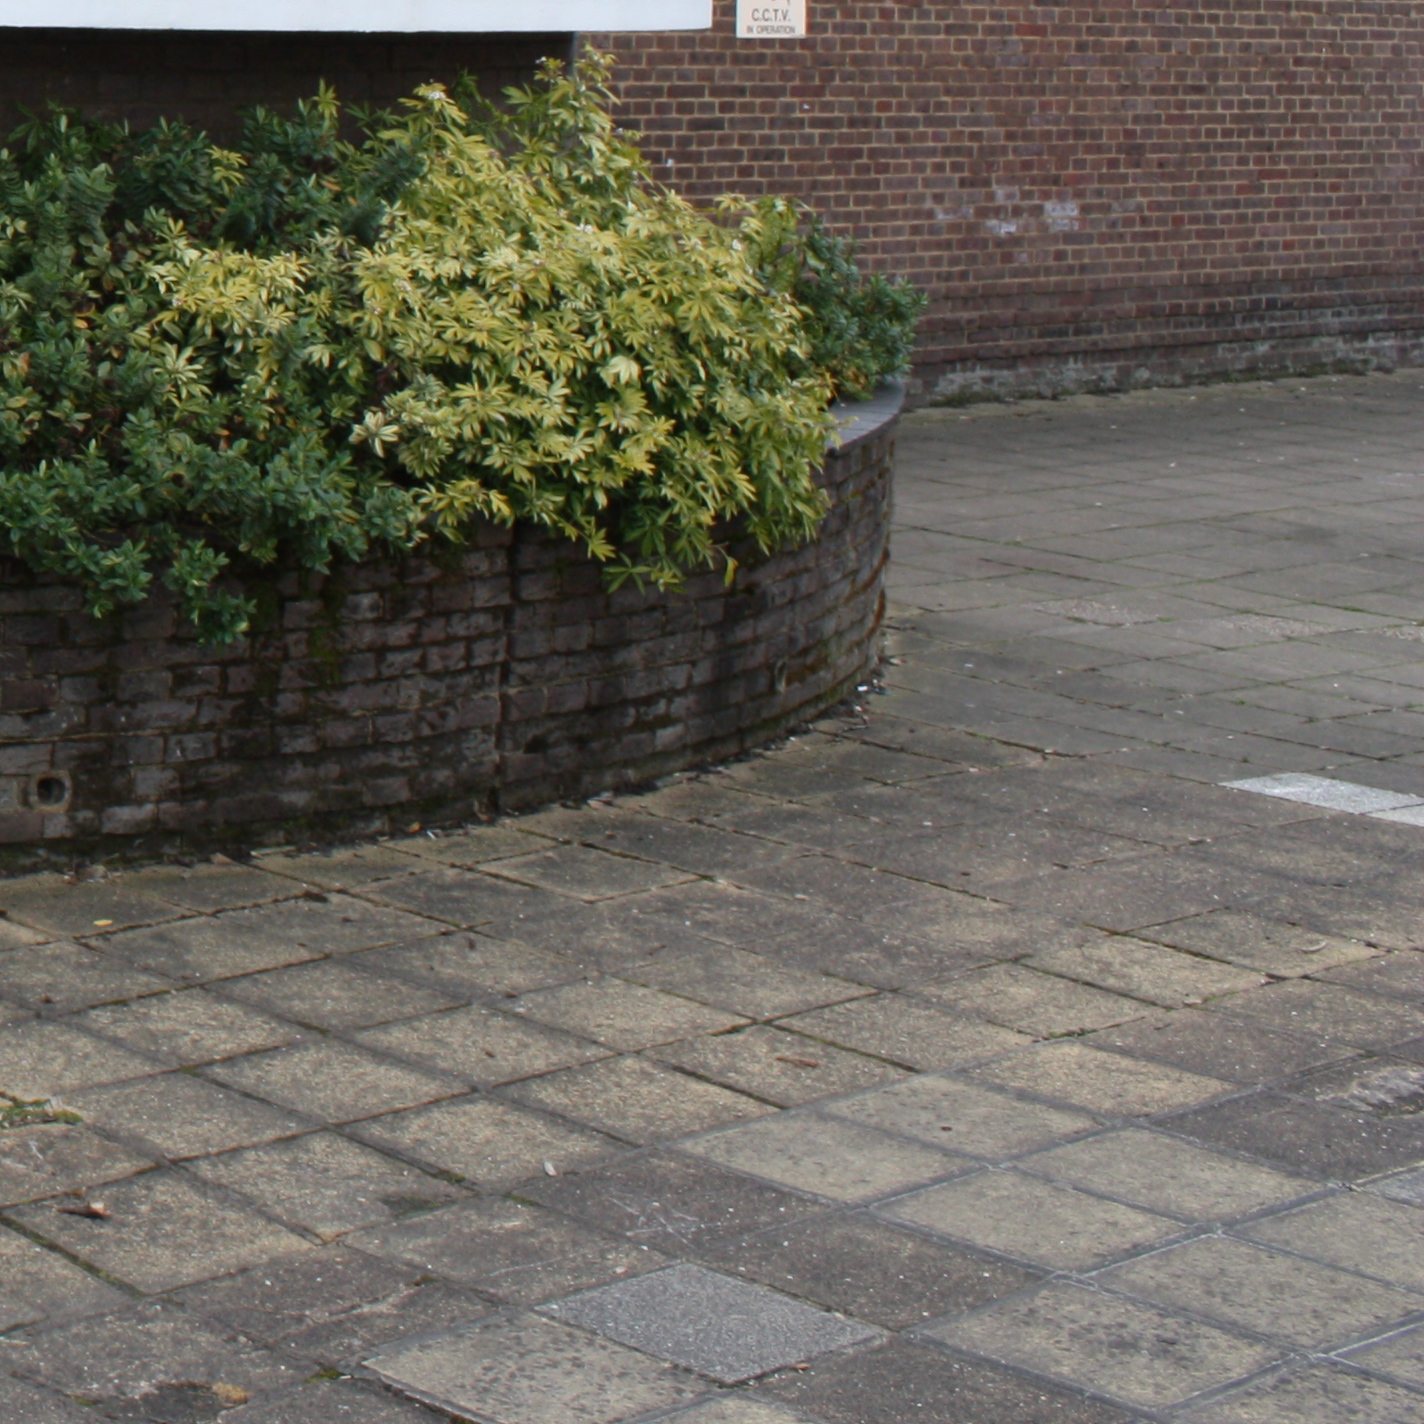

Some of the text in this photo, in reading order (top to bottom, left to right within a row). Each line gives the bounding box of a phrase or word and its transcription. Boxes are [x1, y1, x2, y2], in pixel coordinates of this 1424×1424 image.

[752, 8, 791, 22] C.C.T.V.
[746, 25, 795, 35] IN OPERATION
